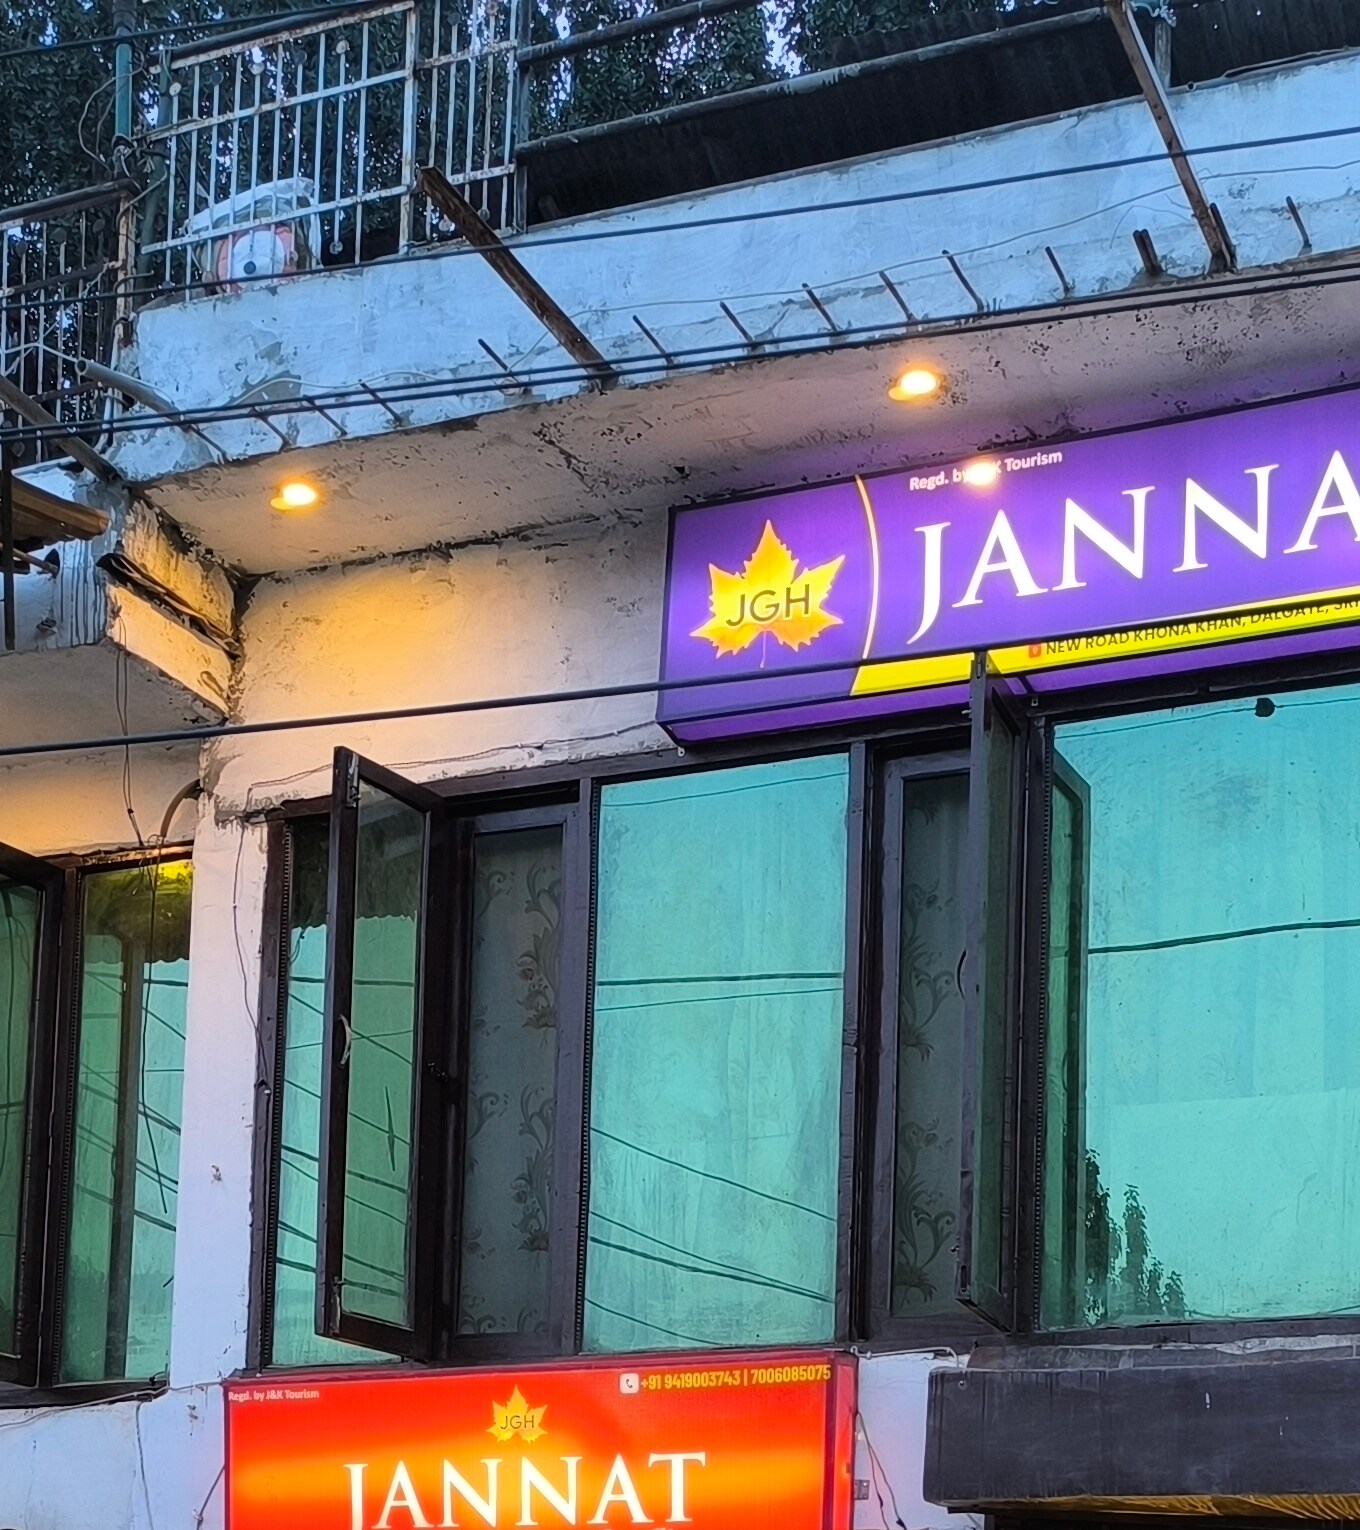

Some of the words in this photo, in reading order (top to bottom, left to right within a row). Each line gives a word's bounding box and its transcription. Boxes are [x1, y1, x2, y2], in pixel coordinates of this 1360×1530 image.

[910, 471, 949, 490] Regd.
[1004, 452, 1063, 472] Tourism
[726, 580, 813, 628] JGH
[1046, 638, 1082, 654] NEW
[1085, 632, 1130, 649] ROAD
[1134, 624, 1191, 641] KHONA
[1195, 616, 1246, 633] KHAN,
[640, 1374, 661, 1390] +91
[664, 1369, 740, 1389] 9419003743
[751, 1365, 831, 1385] 7006085075
[253, 1390, 264, 1402] by
[266, 1390, 283, 1399] J&K
[284, 1389, 319, 1399] Tourism
[500, 1413, 535, 1430] JGH
